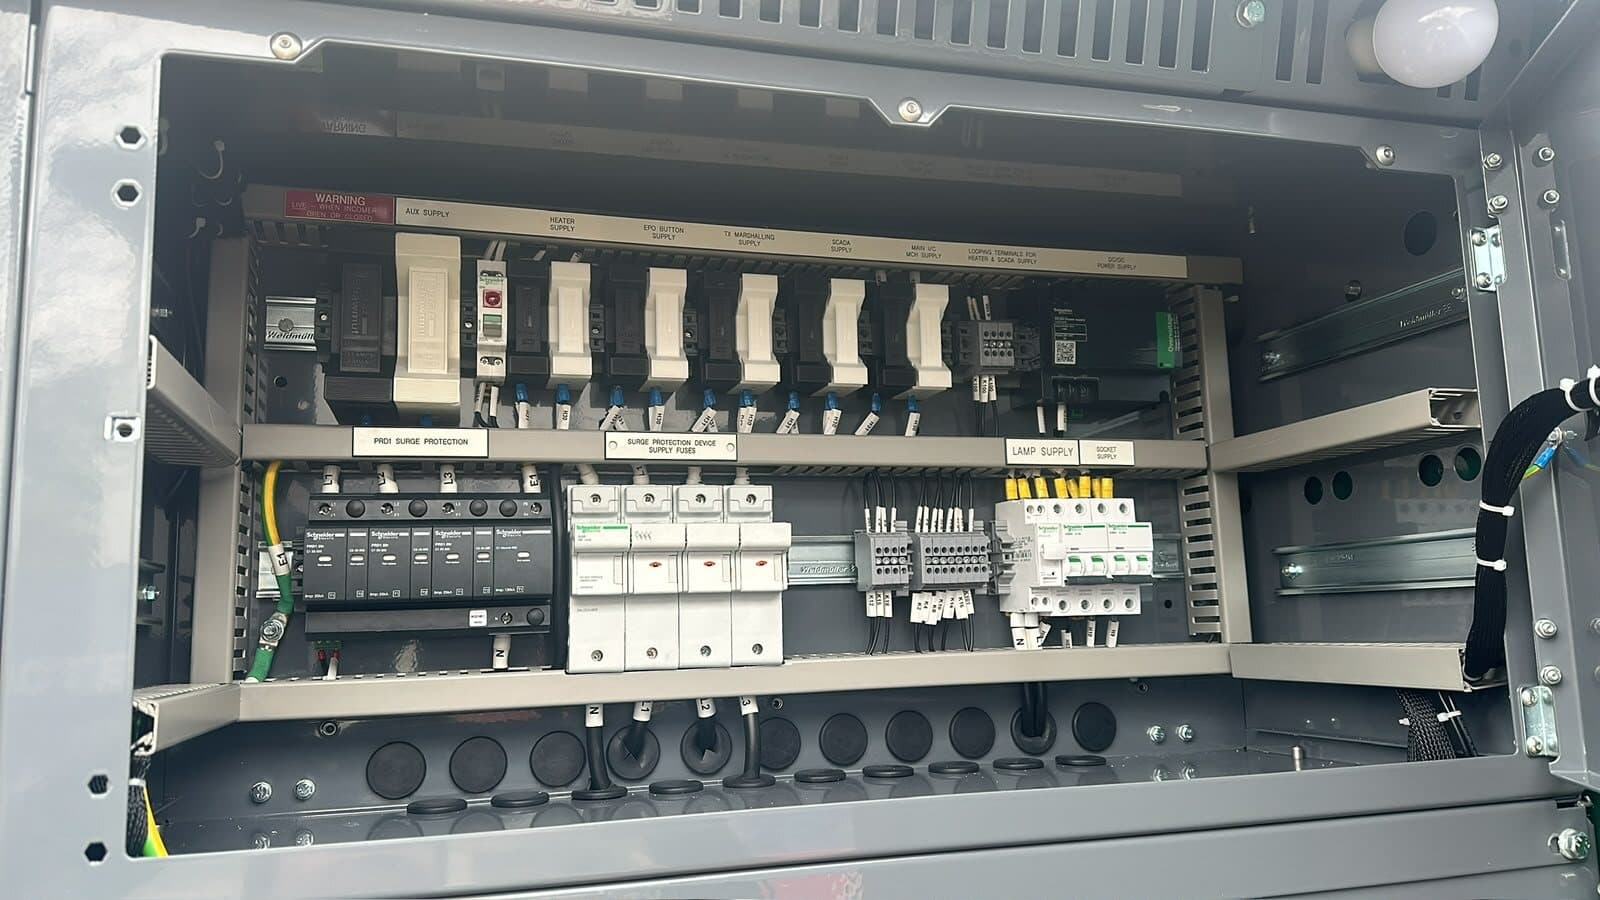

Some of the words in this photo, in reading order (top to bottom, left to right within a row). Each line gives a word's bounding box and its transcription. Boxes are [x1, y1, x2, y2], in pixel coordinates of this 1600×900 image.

[315, 193, 366, 206] WARNING
[291, 201, 306, 210] LIVE
[319, 203, 340, 211] WHEN
[344, 205, 377, 214] INCOMER
[405, 207, 420, 216] AUX
[423, 209, 450, 218] SUPPLY
[306, 210, 327, 218] OPEN
[344, 213, 373, 221] CLOSED
[550, 216, 575, 225] HEATER
[550, 224, 576, 232] SUPPLY
[643, 224, 657, 232] EPO
[659, 225, 685, 234] BUTTON
[652, 232, 676, 241] SUPPLY
[734, 231, 775, 241] MARSHALLING
[738, 239, 761, 247] SUPPLY
[831, 245, 853, 254] SUPPLY
[968, 248, 992, 256] LOOPING
[995, 250, 1023, 258] TERMINALS
[921, 251, 942, 260] SUPPLY
[968, 255, 988, 263] HEATER
[997, 256, 1015, 264] SCADA
[1017, 258, 1037, 266] SUPPLY
[373, 437, 392, 445] PRD1
[395, 437, 421, 445] SURGE
[424, 438, 469, 446] PROTECTION
[627, 438, 649, 446] SURGE
[652, 438, 692, 447] PROTECTION
[694, 439, 717, 447] DEVICE
[648, 446, 673, 454] SUPPLY
[676, 447, 696, 455] FUSES
[1012, 446, 1036, 456] LAMP
[1041, 446, 1074, 457] SUPPLY
[1096, 453, 1118, 461] SUPPLY
[323, 474, 333, 486] L1
[377, 471, 386, 486] L2
[444, 472, 453, 485] L3
[528, 474, 539, 487] E1
[277, 552, 288, 567] E1
[1016, 638, 1025, 646] N
[496, 649, 505, 658] N
[589, 706, 599, 715] N
